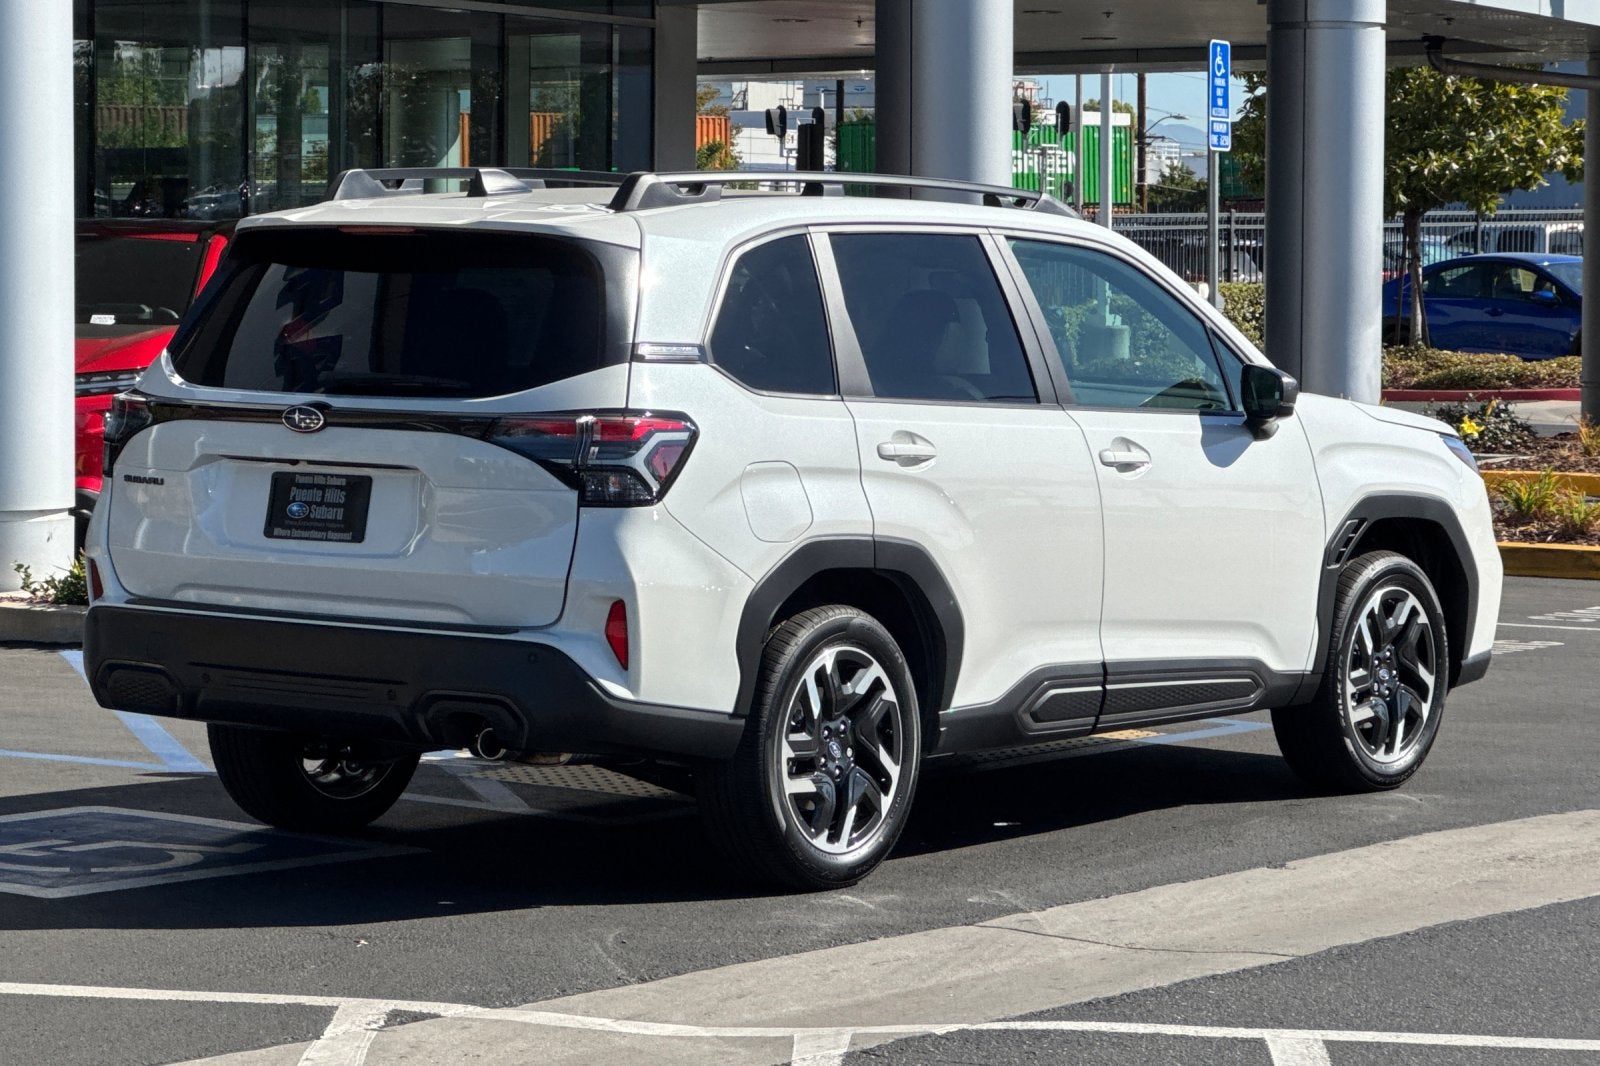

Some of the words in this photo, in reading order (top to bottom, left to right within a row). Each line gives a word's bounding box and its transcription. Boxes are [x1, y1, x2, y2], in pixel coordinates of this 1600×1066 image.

[123, 474, 165, 486] SUBARU
[290, 486, 323, 502] Puente
[324, 488, 347, 504] Hills
[310, 504, 345, 520] Subaru
